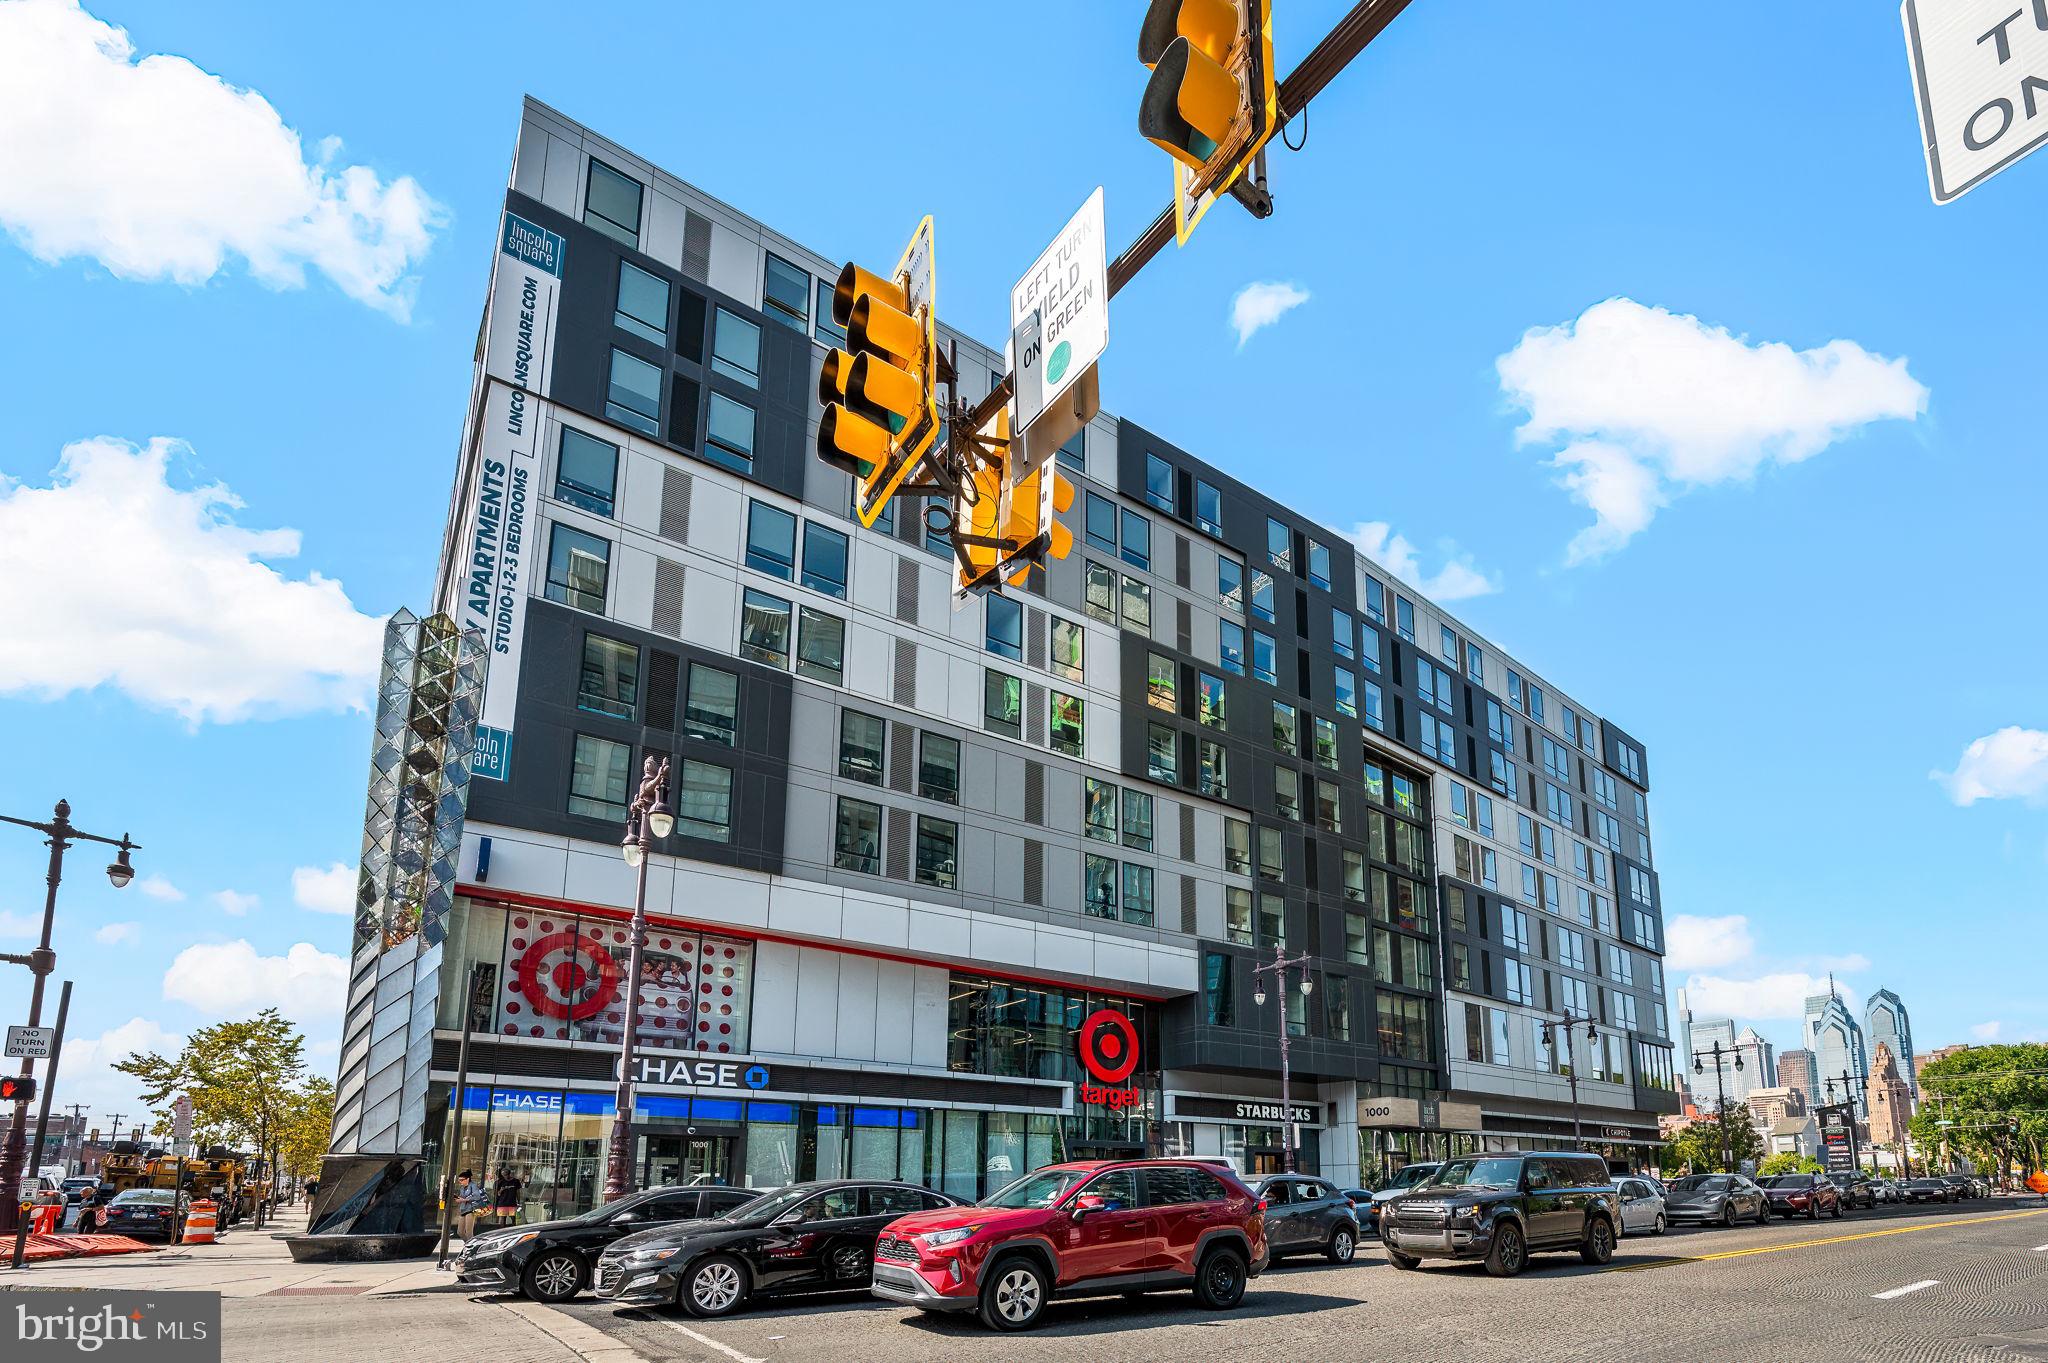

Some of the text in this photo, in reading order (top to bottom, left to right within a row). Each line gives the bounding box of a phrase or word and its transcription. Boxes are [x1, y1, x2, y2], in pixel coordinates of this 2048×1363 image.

[508, 236, 553, 267] square
[512, 220, 553, 254] lincoln
[1020, 216, 1093, 312] LEFT TURN
[1033, 262, 1081, 327] YIELD
[1023, 280, 1094, 368] ON GREEN
[507, 275, 538, 436] LINCOLNSQUARE.COM
[506, 466, 529, 555] BEDROOMS
[468, 458, 506, 617] APARTMENTS
[10, 1046, 24, 1054] ON
[15, 1038, 45, 1046] TURN
[616, 1057, 738, 1087] CHASE
[492, 1093, 562, 1109] CHASE
[1080, 1081, 1140, 1111] target
[1365, 1106, 1390, 1117] 1000
[1236, 1103, 1311, 1121] STARBUCKS
